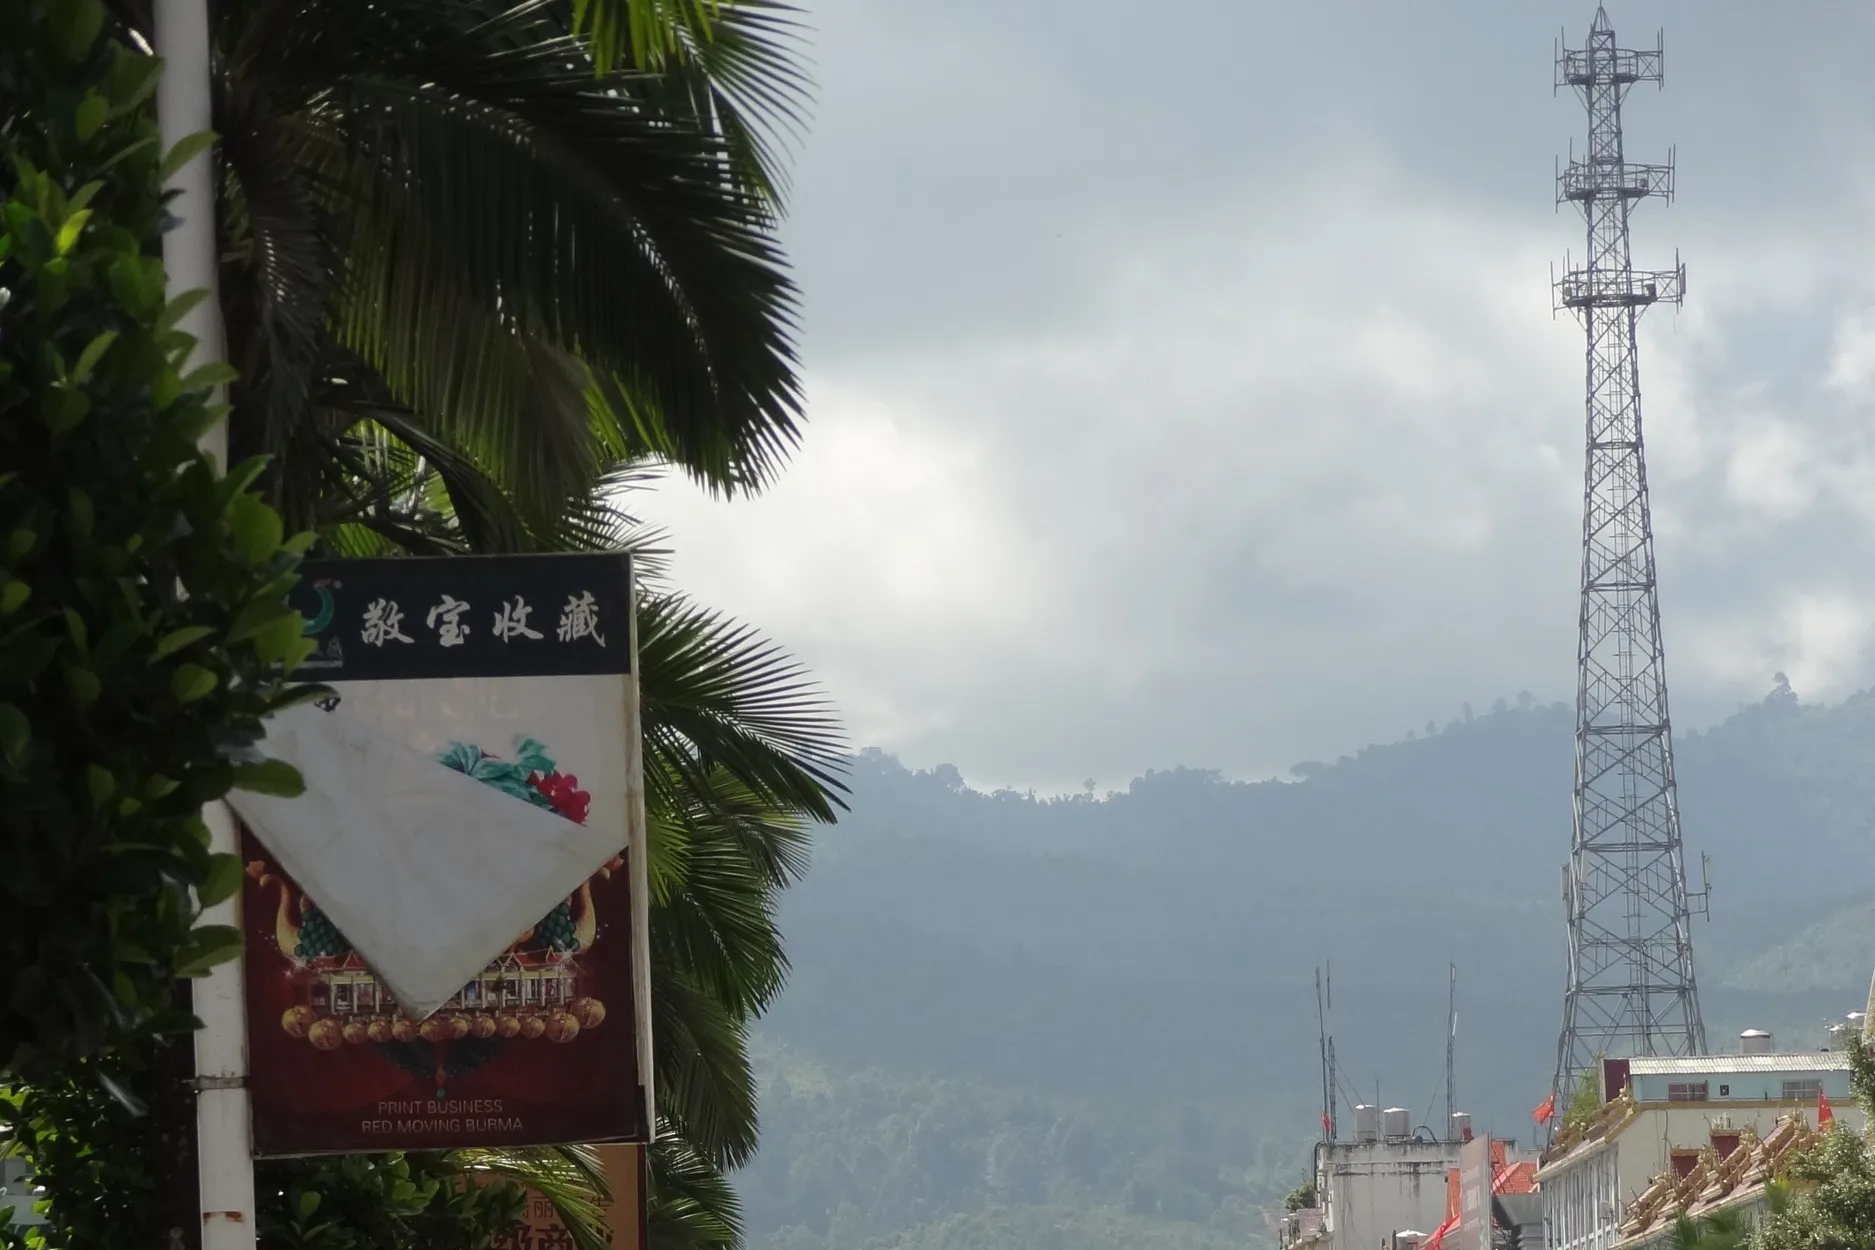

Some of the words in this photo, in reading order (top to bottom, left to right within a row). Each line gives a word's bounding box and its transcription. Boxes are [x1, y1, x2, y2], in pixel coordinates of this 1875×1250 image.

[378, 1101, 422, 1115] PRINT
[427, 1099, 503, 1114] BUSINESS
[361, 1120, 393, 1134] RED
[397, 1119, 460, 1133] MOVING
[466, 1117, 523, 1132] BURMA
